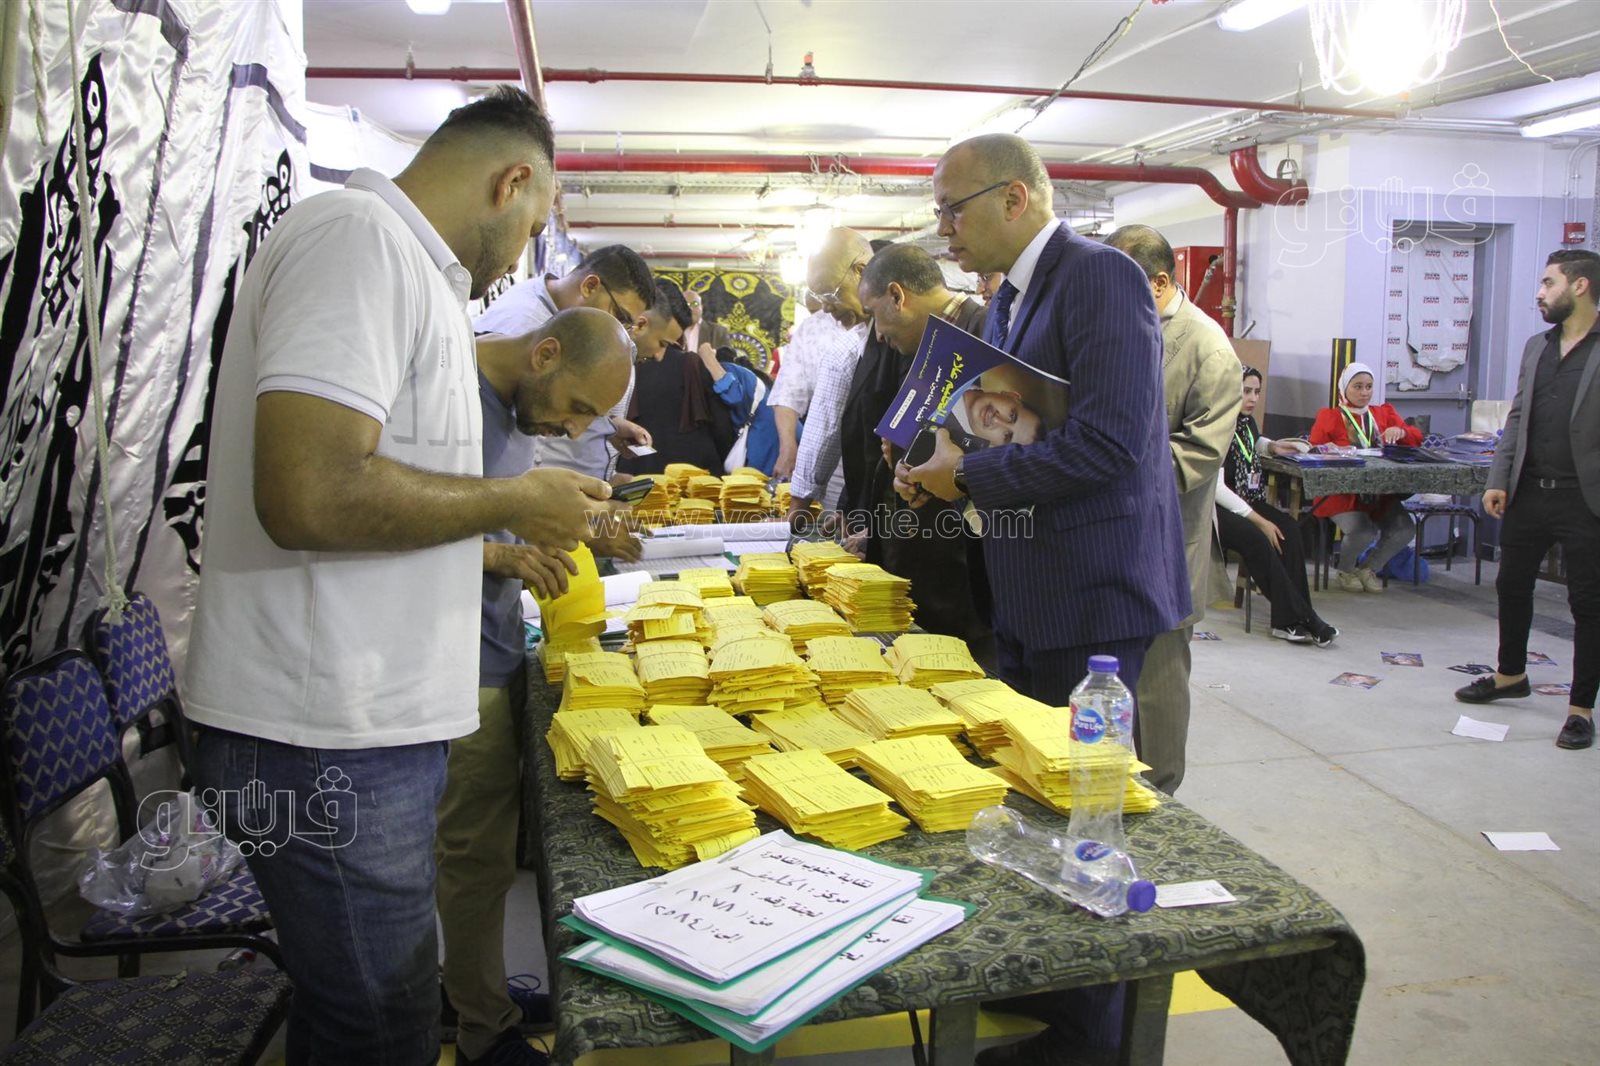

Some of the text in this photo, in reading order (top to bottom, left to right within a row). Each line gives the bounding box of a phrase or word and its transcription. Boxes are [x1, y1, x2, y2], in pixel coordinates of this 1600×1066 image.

[950, 352, 964, 380] علام
[760, 850, 874, 889] نقابة جنوب القاهرة
[787, 902, 823, 918] لجنة
[892, 915, 914, 924] نقا
[864, 932, 890, 943] مرك
